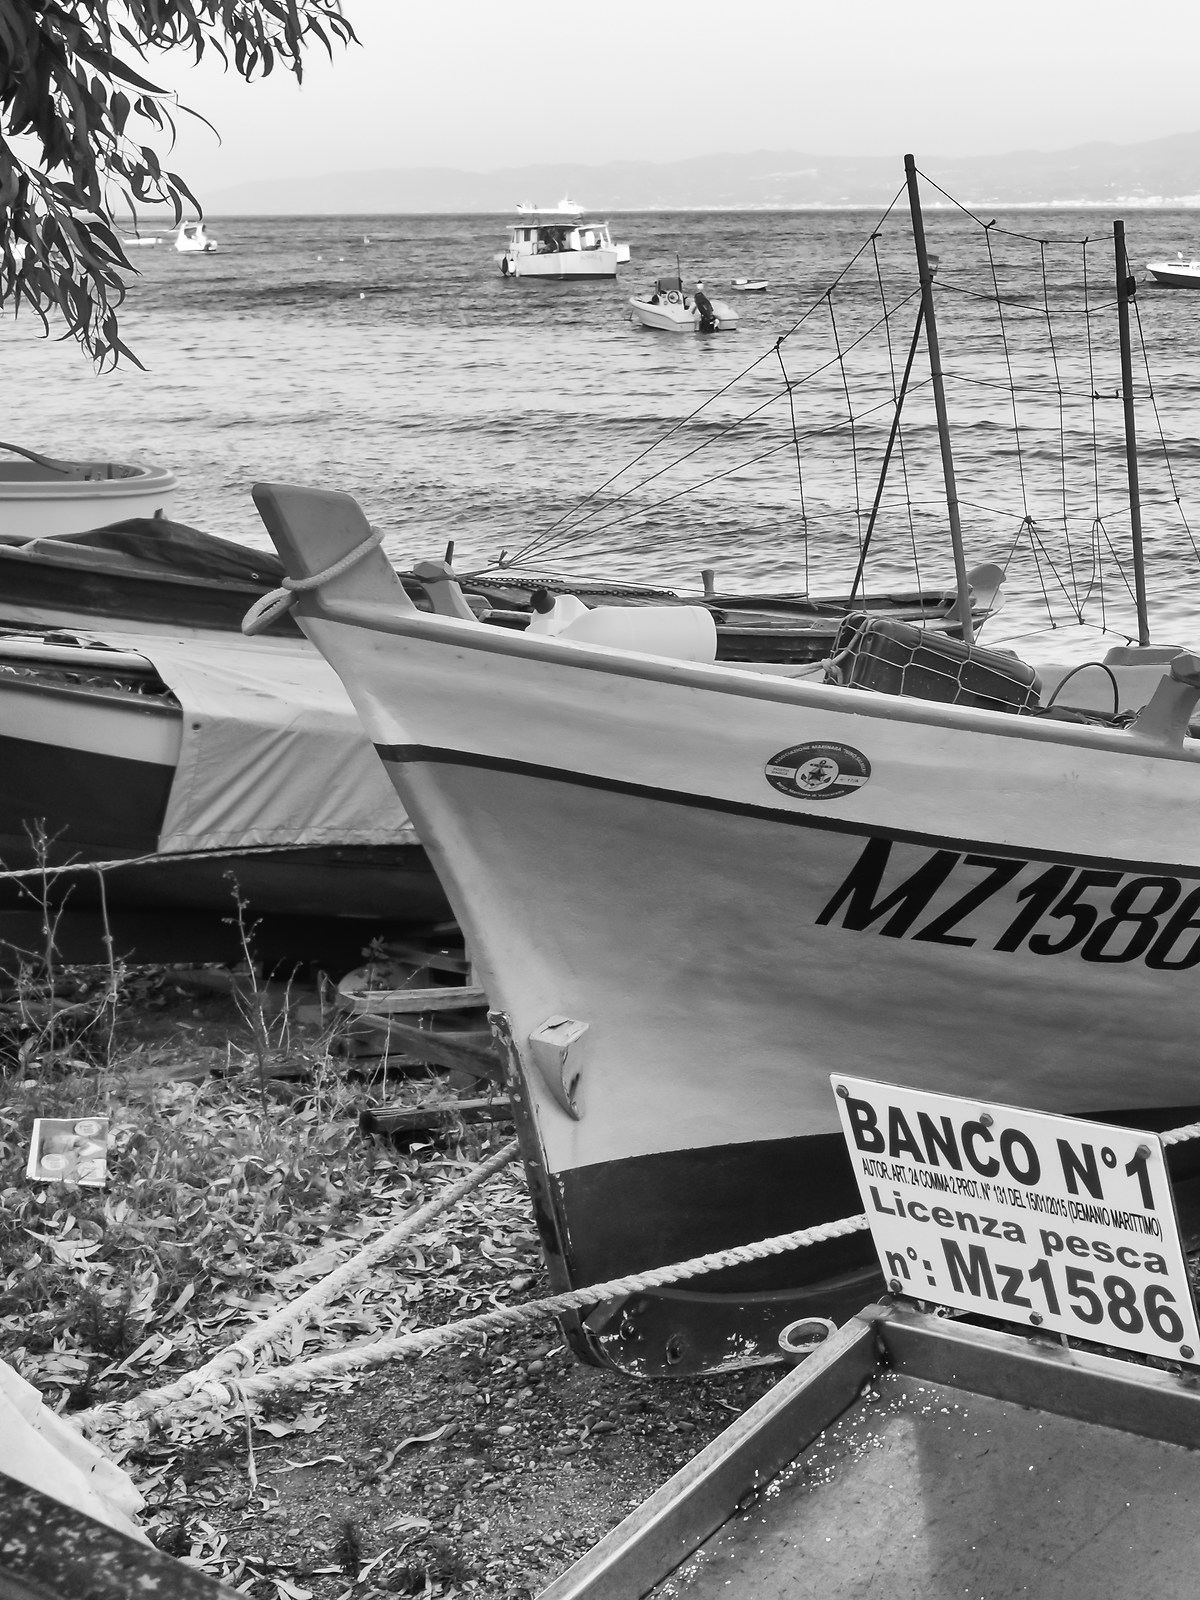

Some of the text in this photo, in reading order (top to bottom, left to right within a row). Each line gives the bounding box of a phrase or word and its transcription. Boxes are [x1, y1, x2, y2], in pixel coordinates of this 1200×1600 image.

[845, 1098, 1041, 1186] BANCO
[862, 1158, 892, 1181] AUTOR.
[891, 1164, 910, 1184] ART.
[908, 1167, 920, 1186] 24
[920, 1169, 952, 1193] COMMA
[950, 1176, 958, 1194] 2
[956, 1177, 982, 1199] PROT.
[993, 1184, 1008, 1205] 131
[1008, 1188, 1026, 1208] DEL
[1025, 1192, 1068, 1217] 15/01/2015
[1068, 1200, 1111, 1227] (DEMANIO
[1110, 1208, 1163, 1242] MARITTIMO)
[869, 1186, 1169, 1275] Licenza pesca
[940, 1238, 1185, 1343] Mz1586
